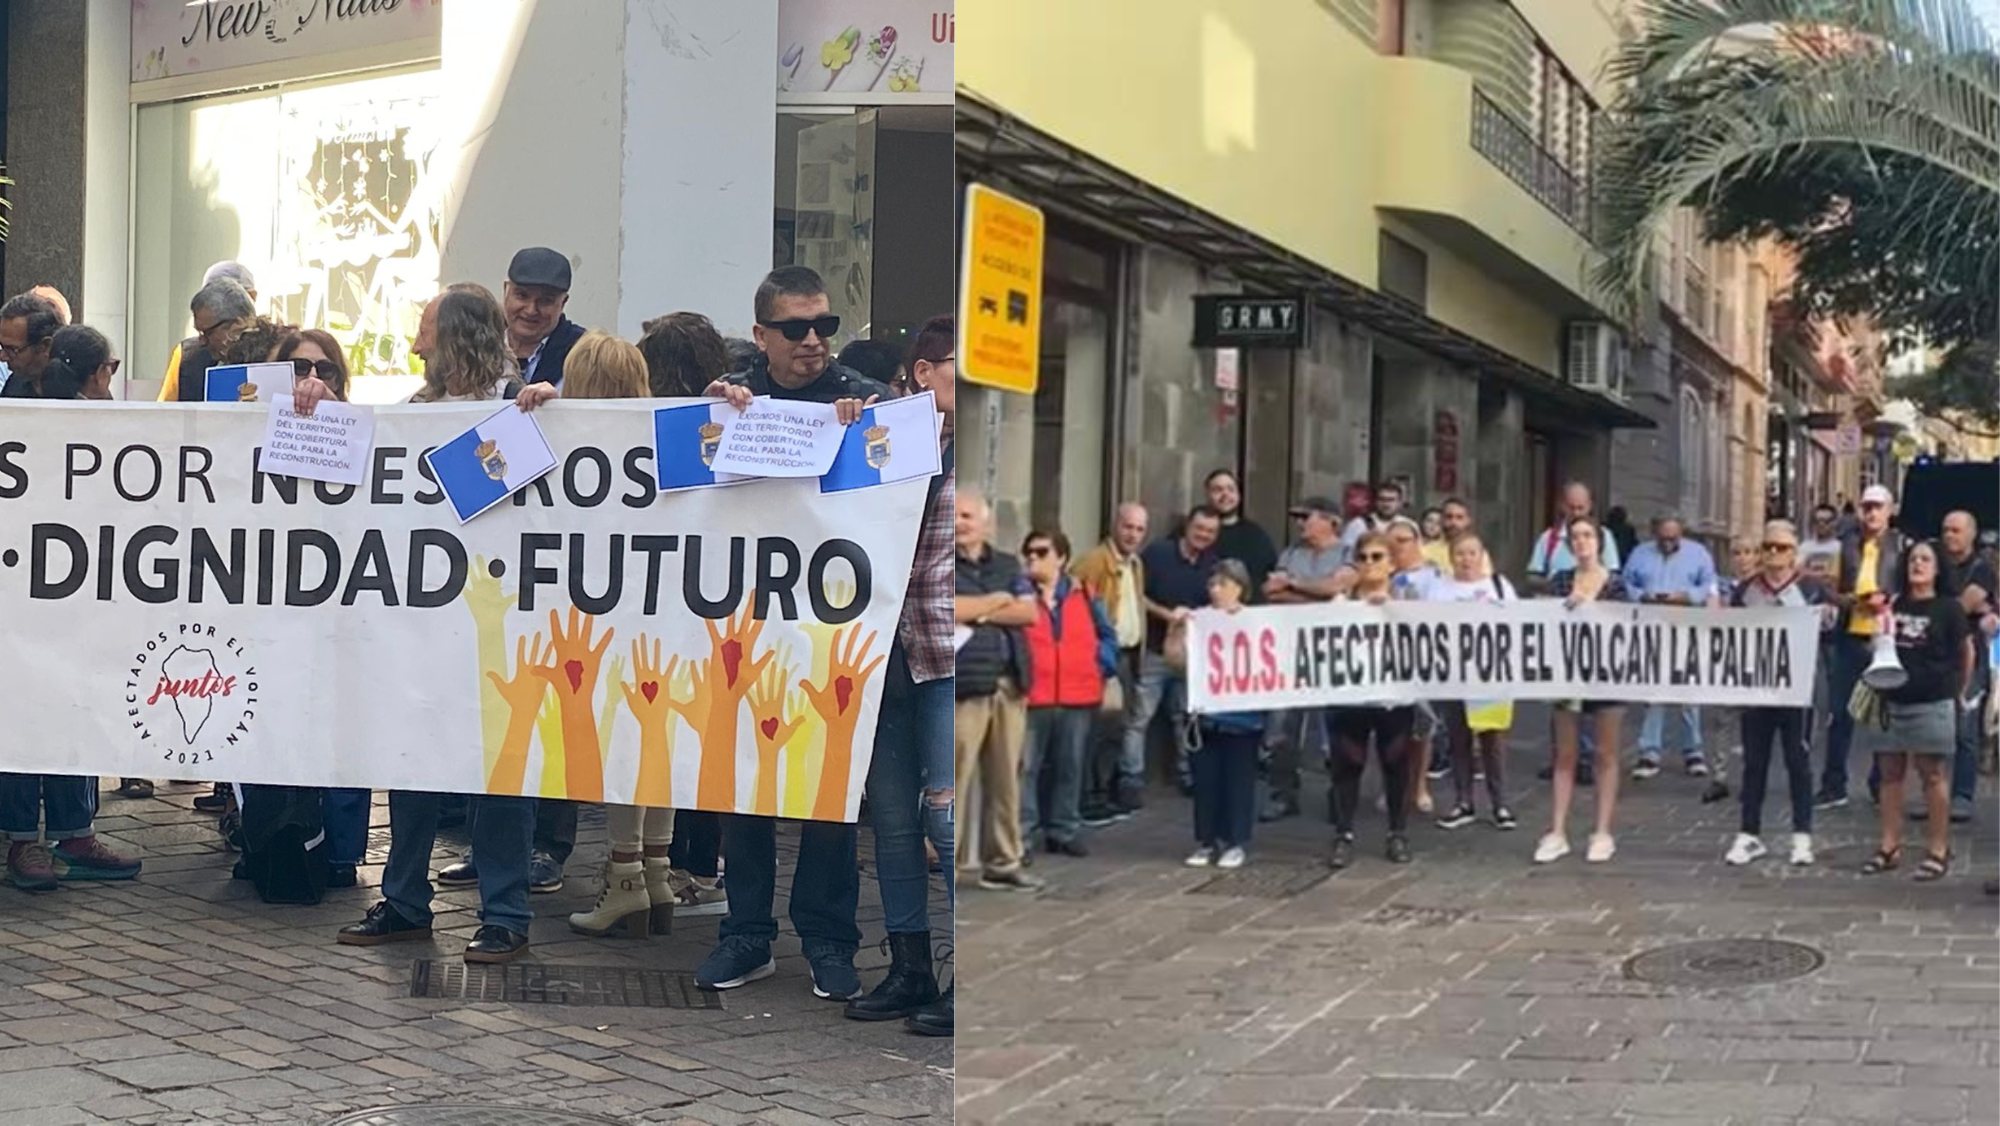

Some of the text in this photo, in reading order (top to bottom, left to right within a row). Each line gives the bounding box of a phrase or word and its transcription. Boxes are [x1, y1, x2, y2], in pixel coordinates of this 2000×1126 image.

[182, 0, 270, 44] New
[276, 419, 346, 436] DEL TERRITORIO
[321, 415, 340, 424] UNA
[341, 417, 357, 426] LEY
[783, 415, 804, 425] UNA
[806, 418, 826, 428] LEY
[274, 430, 348, 447] CON COBERTURA
[735, 422, 813, 438] DEL TERRITORIO
[271, 441, 337, 457] LEGAL PARA LA
[732, 433, 814, 448] CON COBERTURA
[728, 443, 802, 457] LEGAL PARA LA
[65, 443, 216, 503] POR
[30, 522, 872, 625] DIGNIDAD FUTURO
[1208, 608, 1792, 695] S.O.S. AFECTADOS POR EL VOLCÁN LA PALMA
[126, 632, 167, 740] AFECTADOS
[179, 623, 216, 637] POR
[226, 637, 244, 657] EL
[147, 668, 237, 705] juntos
[164, 748, 214, 765] 2021
